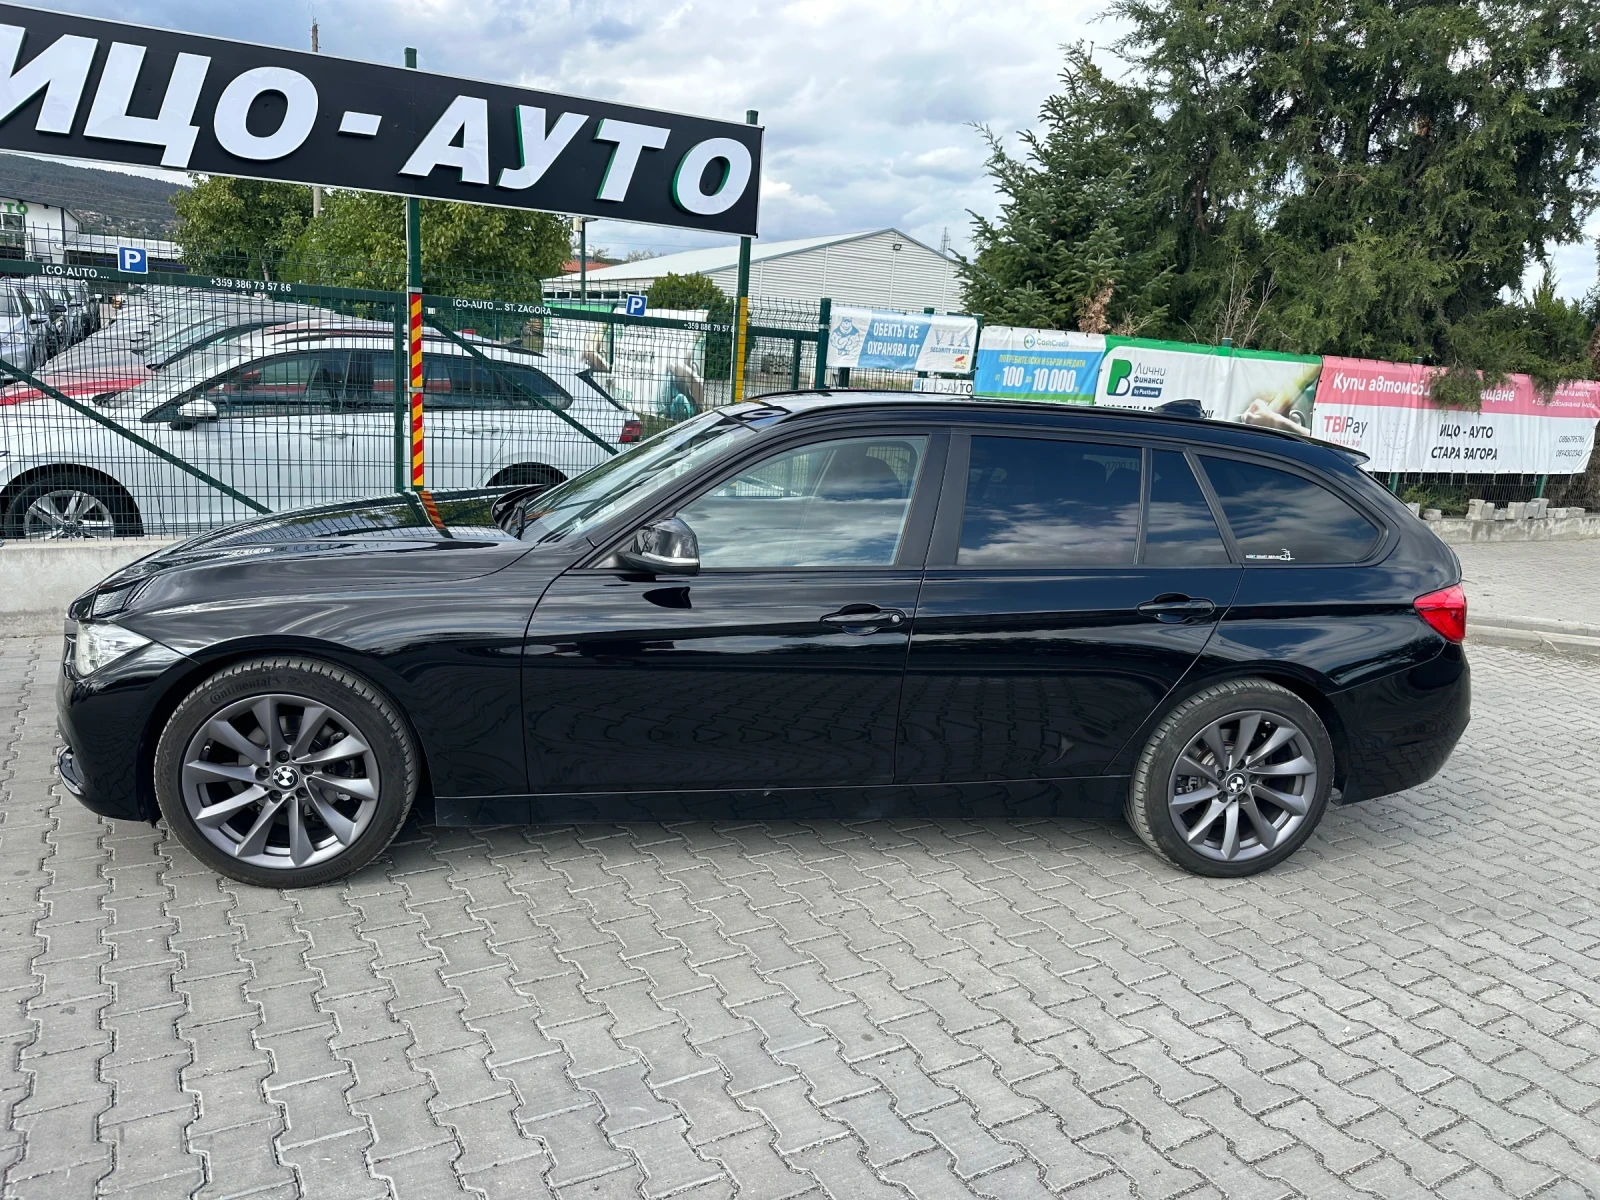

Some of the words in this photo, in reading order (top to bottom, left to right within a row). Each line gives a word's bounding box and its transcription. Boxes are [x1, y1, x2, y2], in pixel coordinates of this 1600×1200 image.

[338, 110, 382, 136] -
[398, 95, 752, 215] АУТО
[124, 249, 141, 269] P
[210, 278, 233, 287] +359
[254, 281, 265, 290] 79
[267, 282, 278, 291] 57
[280, 283, 292, 292] 86
[504, 303, 517, 312] ST.
[518, 304, 552, 316] ZAGORA
[630, 298, 643, 314] P
[873, 321, 907, 338] ОБЕКТЪТ
[908, 324, 919, 339] СЕ
[934, 329, 971, 348] VTA
[1036, 338, 1070, 348] CashCredit
[867, 342, 908, 357] ОХРАНЯВА
[909, 344, 920, 358] ОТ
[930, 346, 951, 354] SECURITY
[951, 347, 970, 355] SERVICE
[1002, 366, 1025, 387] 100
[1135, 362, 1166, 376] Лични
[1332, 373, 1366, 393] Купи
[1440, 424, 1461, 439] ИЦО
[1469, 425, 1494, 439] АУТО
[1431, 446, 1460, 460] СТАРА
[1463, 447, 1498, 460] ЗАГОРА
[209, 675, 271, 705] Continental
